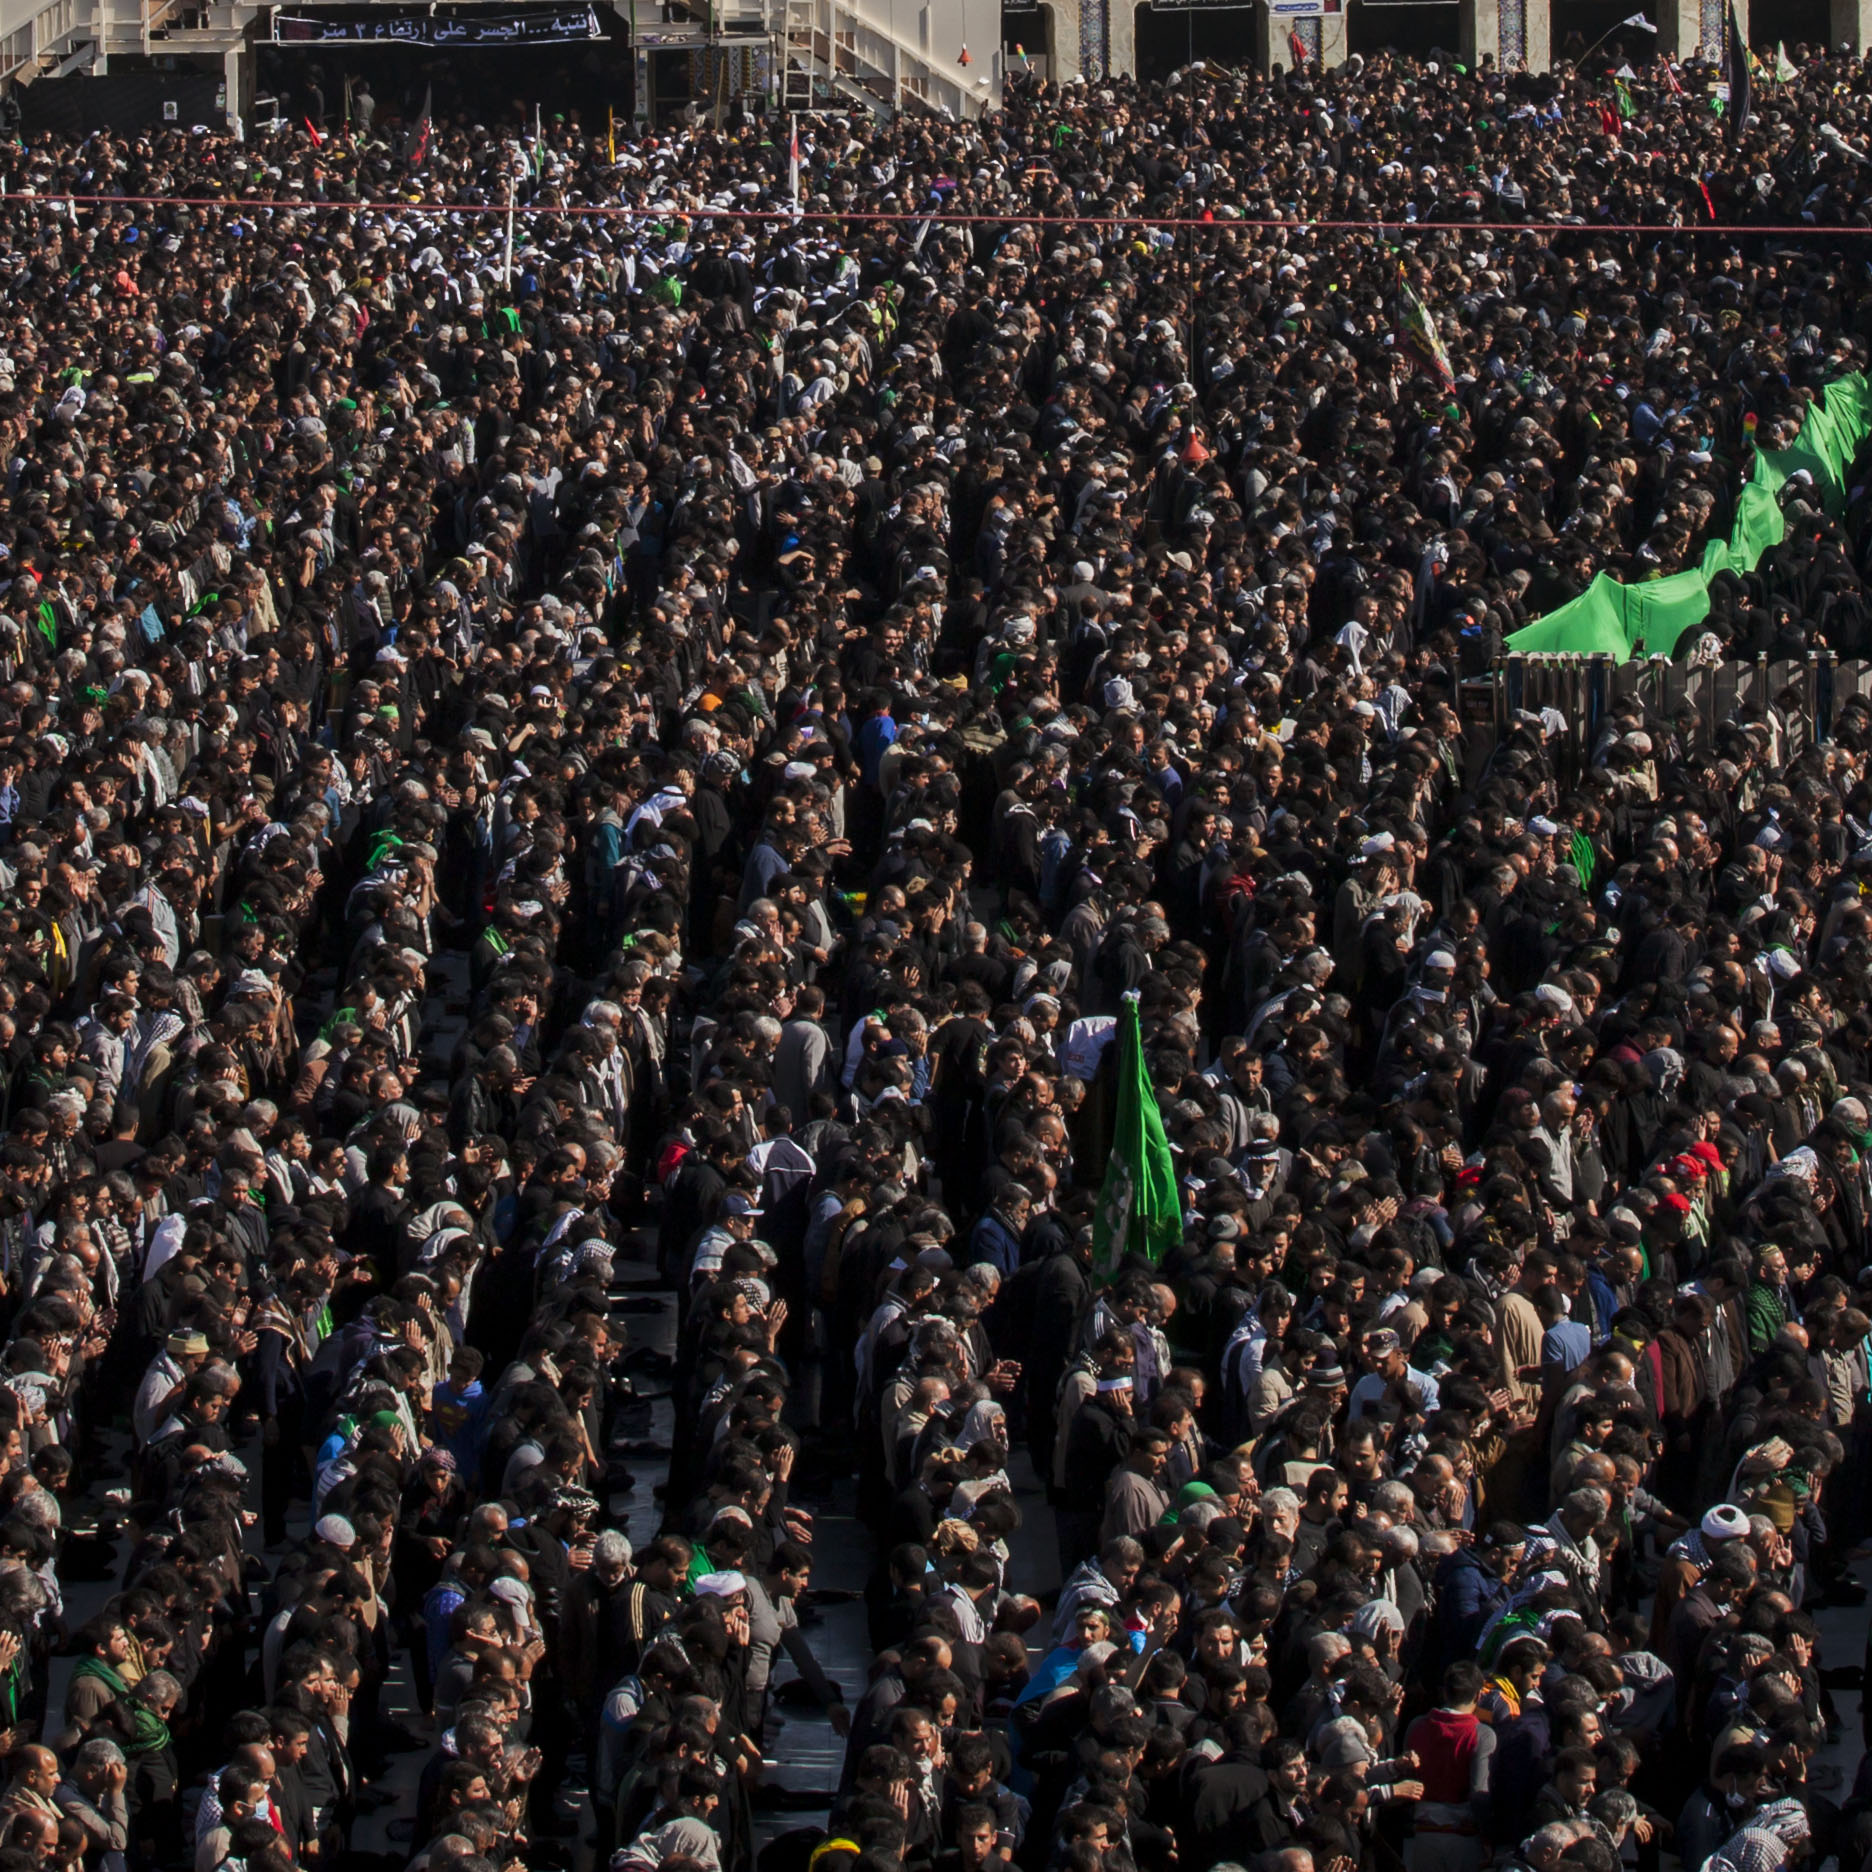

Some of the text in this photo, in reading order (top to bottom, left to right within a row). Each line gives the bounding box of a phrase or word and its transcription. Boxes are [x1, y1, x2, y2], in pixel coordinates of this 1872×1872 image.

[318, 21, 348, 41] متر
[356, 23, 366, 37] ٣
[433, 22, 468, 41] على
[474, 21, 526, 42] الجسر
